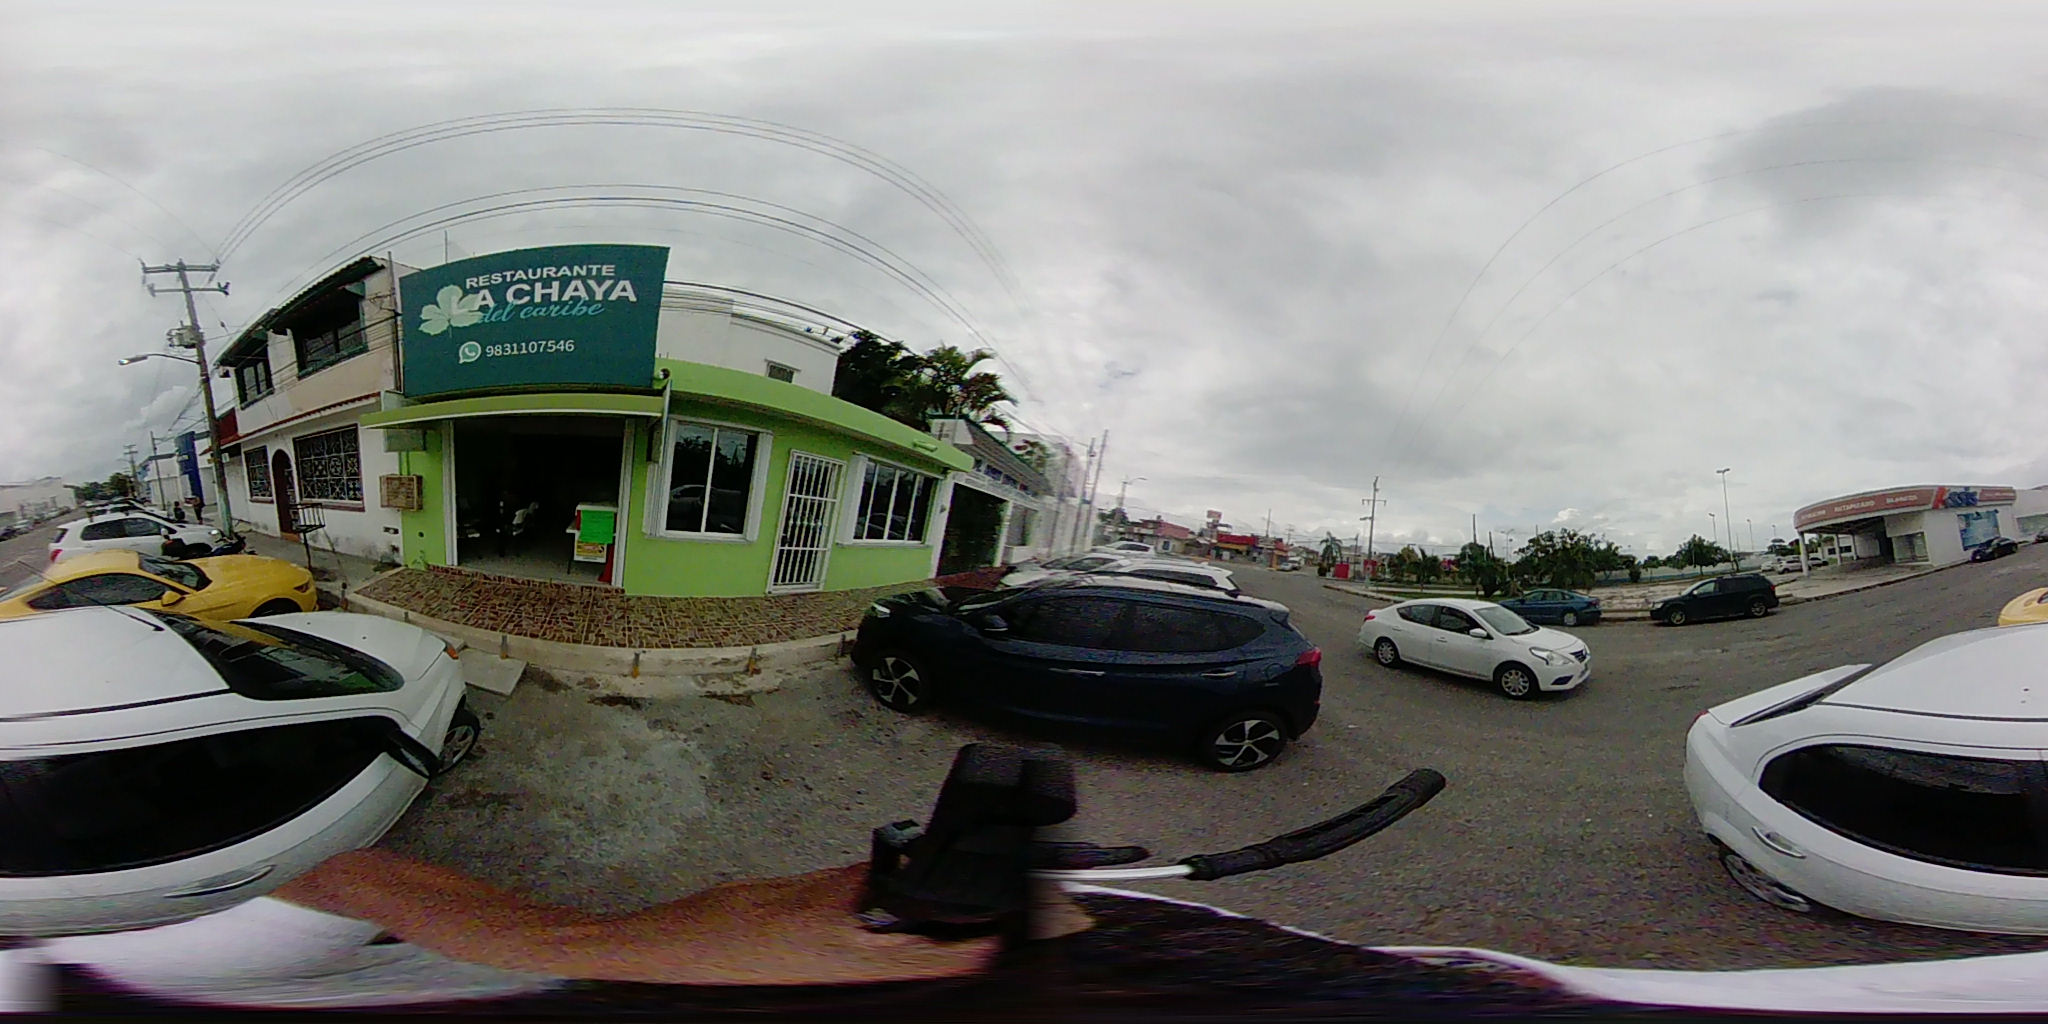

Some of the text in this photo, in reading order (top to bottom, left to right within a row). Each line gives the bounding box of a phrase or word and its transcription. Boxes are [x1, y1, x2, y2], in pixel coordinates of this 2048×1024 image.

[465, 264, 616, 289] RESTAURANTE
[506, 279, 638, 305] CHAYA
[477, 297, 605, 323] del caribe
[485, 339, 575, 357] 9831107546
